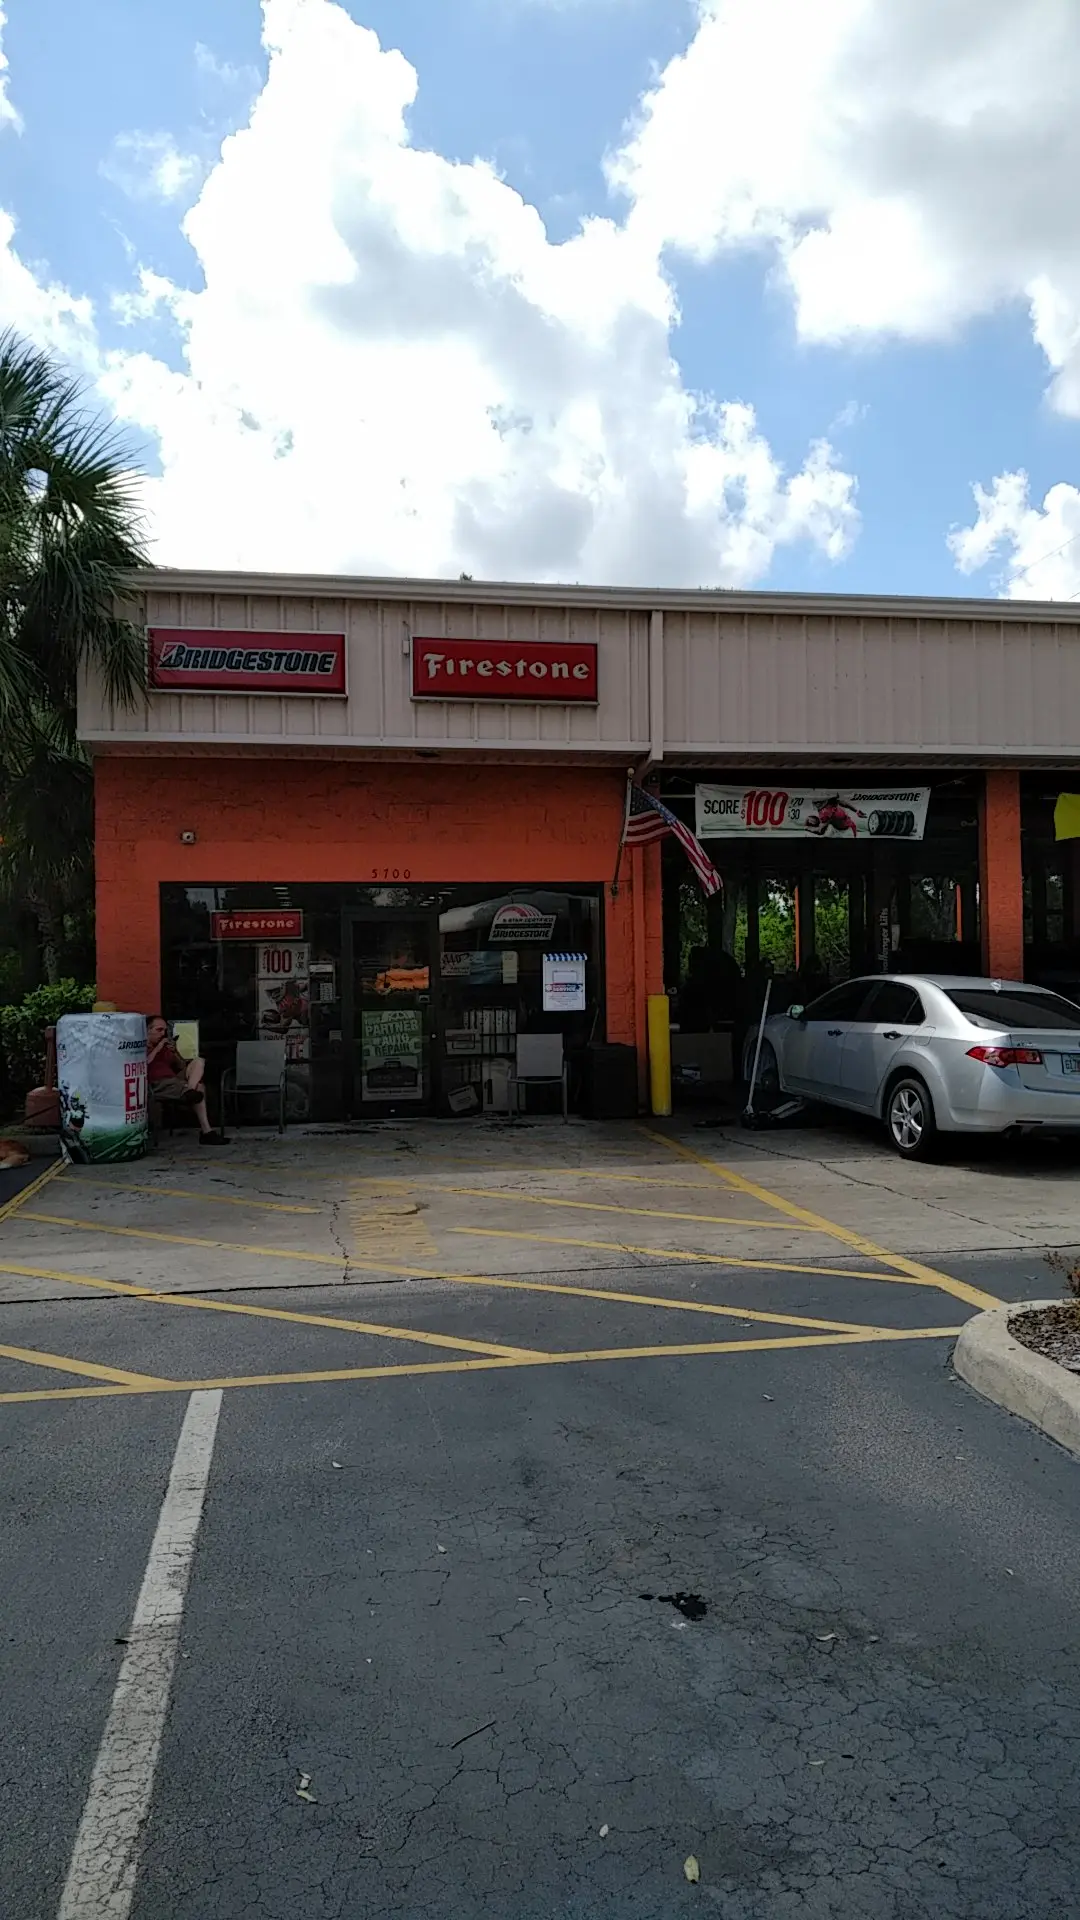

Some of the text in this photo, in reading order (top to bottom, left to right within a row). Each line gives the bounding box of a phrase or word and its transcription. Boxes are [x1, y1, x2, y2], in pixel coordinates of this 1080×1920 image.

[159, 643, 334, 673] BRIDGESTONE
[422, 652, 590, 680] Firestone
[850, 792, 920, 802] BRIDGESTONE
[704, 799, 739, 814] SCORE
[219, 919, 295, 930] Firestone
[493, 930, 550, 938] BRIDGESTONE
[365, 1019, 418, 1037] PARTNER
